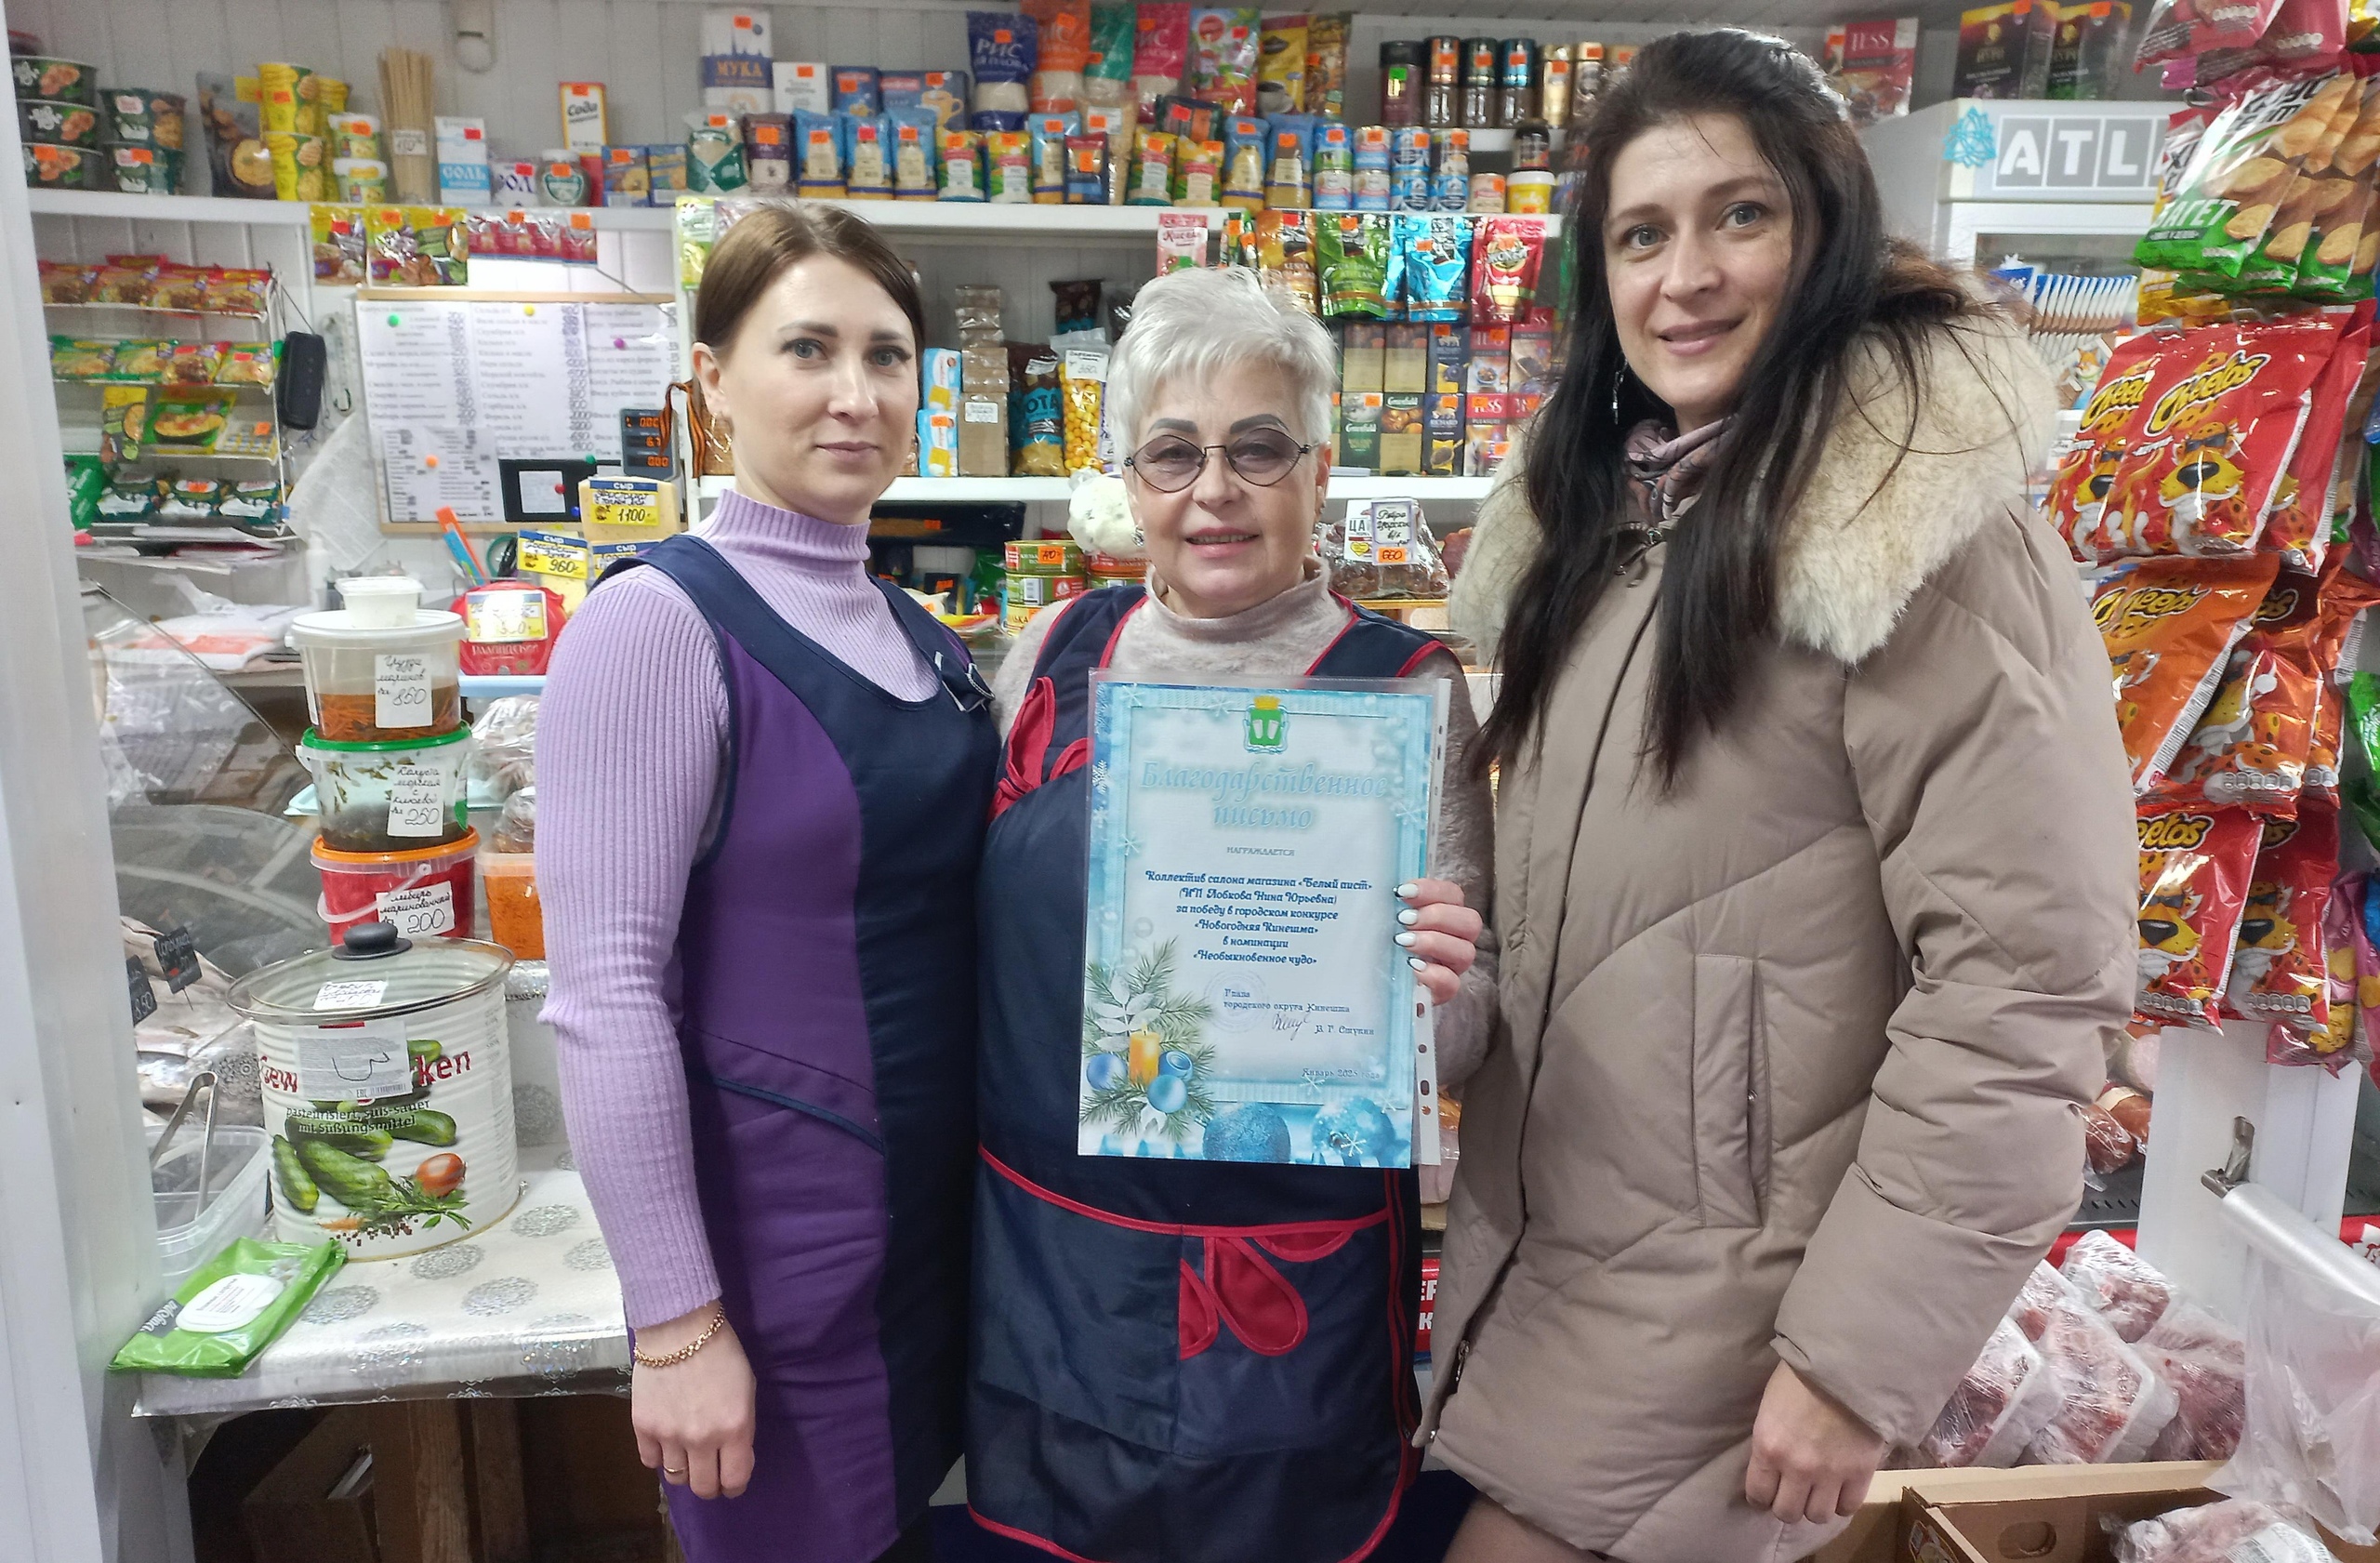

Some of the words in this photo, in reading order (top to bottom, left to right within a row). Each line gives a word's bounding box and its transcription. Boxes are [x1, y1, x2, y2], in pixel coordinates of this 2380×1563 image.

[568, 100, 598, 116] Сода
[2146, 351, 2270, 436] Cheetos
[1142, 755, 1388, 803] Благодарственное
[1213, 805, 1314, 830] письмо
[2137, 813, 2215, 852] eetos
[1226, 845, 1295, 857] НАГРАЖДАЕТСЯ
[1145, 870, 1206, 884] Коллектив
[1208, 874, 1245, 885] салона
[1247, 877, 1296, 887] магазина
[1179, 887, 1202, 899] (ИП
[1206, 888, 1252, 901] Лобкова
[1254, 890, 1283, 902] Нина
[1285, 891, 1338, 906] Юрьевна)
[407, 908, 445, 934] 200
[1176, 905, 1188, 914] за
[1189, 905, 1226, 918] победу
[1235, 908, 1289, 919] городском
[1290, 910, 1339, 921] конкурсе
[1231, 938, 1289, 951] номинации
[1224, 987, 1250, 999] Глава
[1223, 1000, 1271, 1011] городского
[1273, 1002, 1303, 1013] округа
[1306, 1002, 1351, 1013] Кинешма
[1338, 1027, 1375, 1037] Ступин
[298, 1122, 318, 1134] mit
